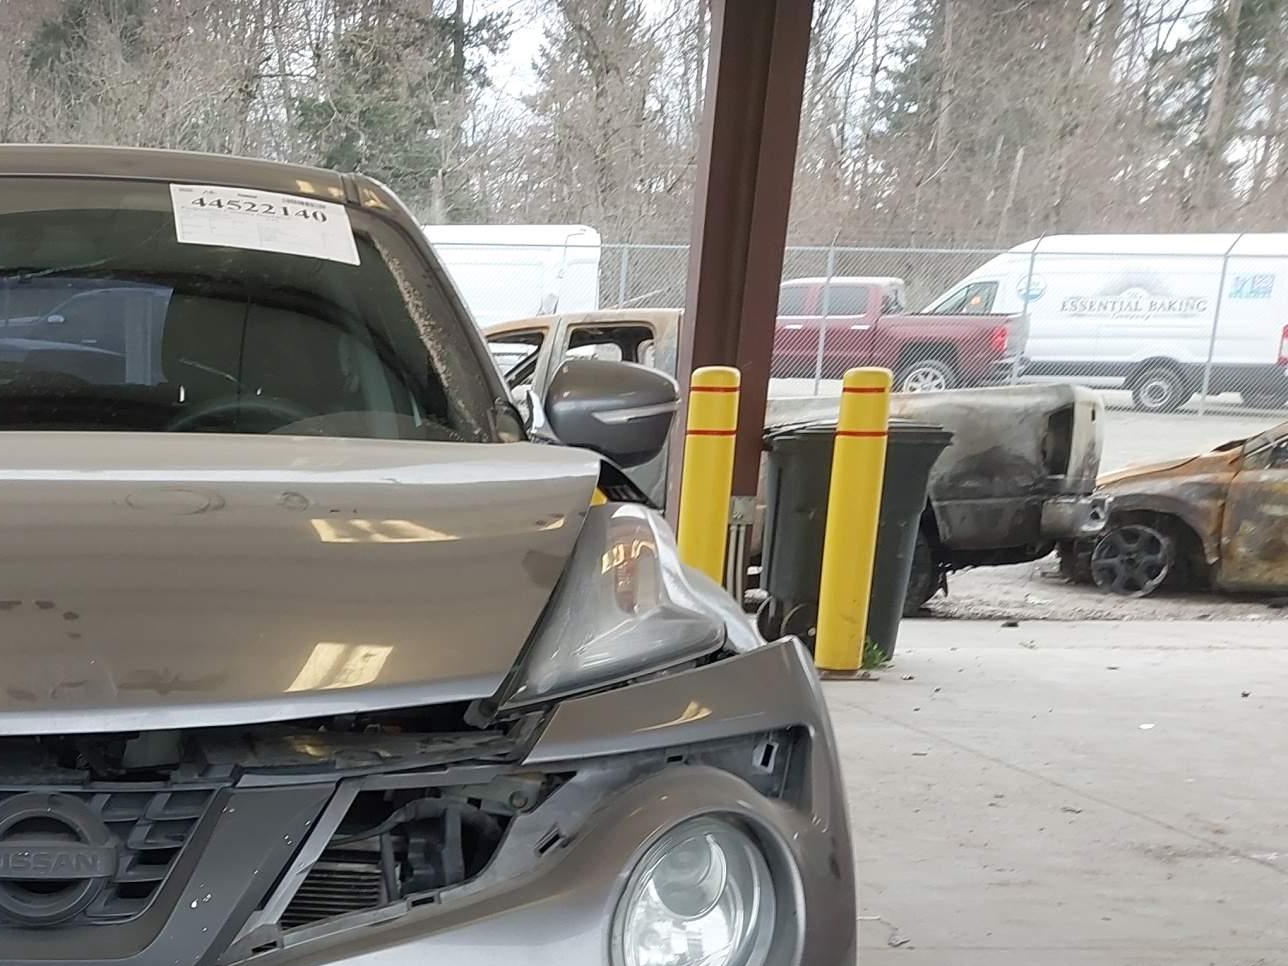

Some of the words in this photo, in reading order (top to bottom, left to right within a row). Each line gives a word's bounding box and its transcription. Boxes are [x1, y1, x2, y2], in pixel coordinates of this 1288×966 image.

[191, 197, 328, 223] 44522140
[1060, 299, 1143, 313] ESSENTIAL
[1148, 299, 1208, 313] BAKING
